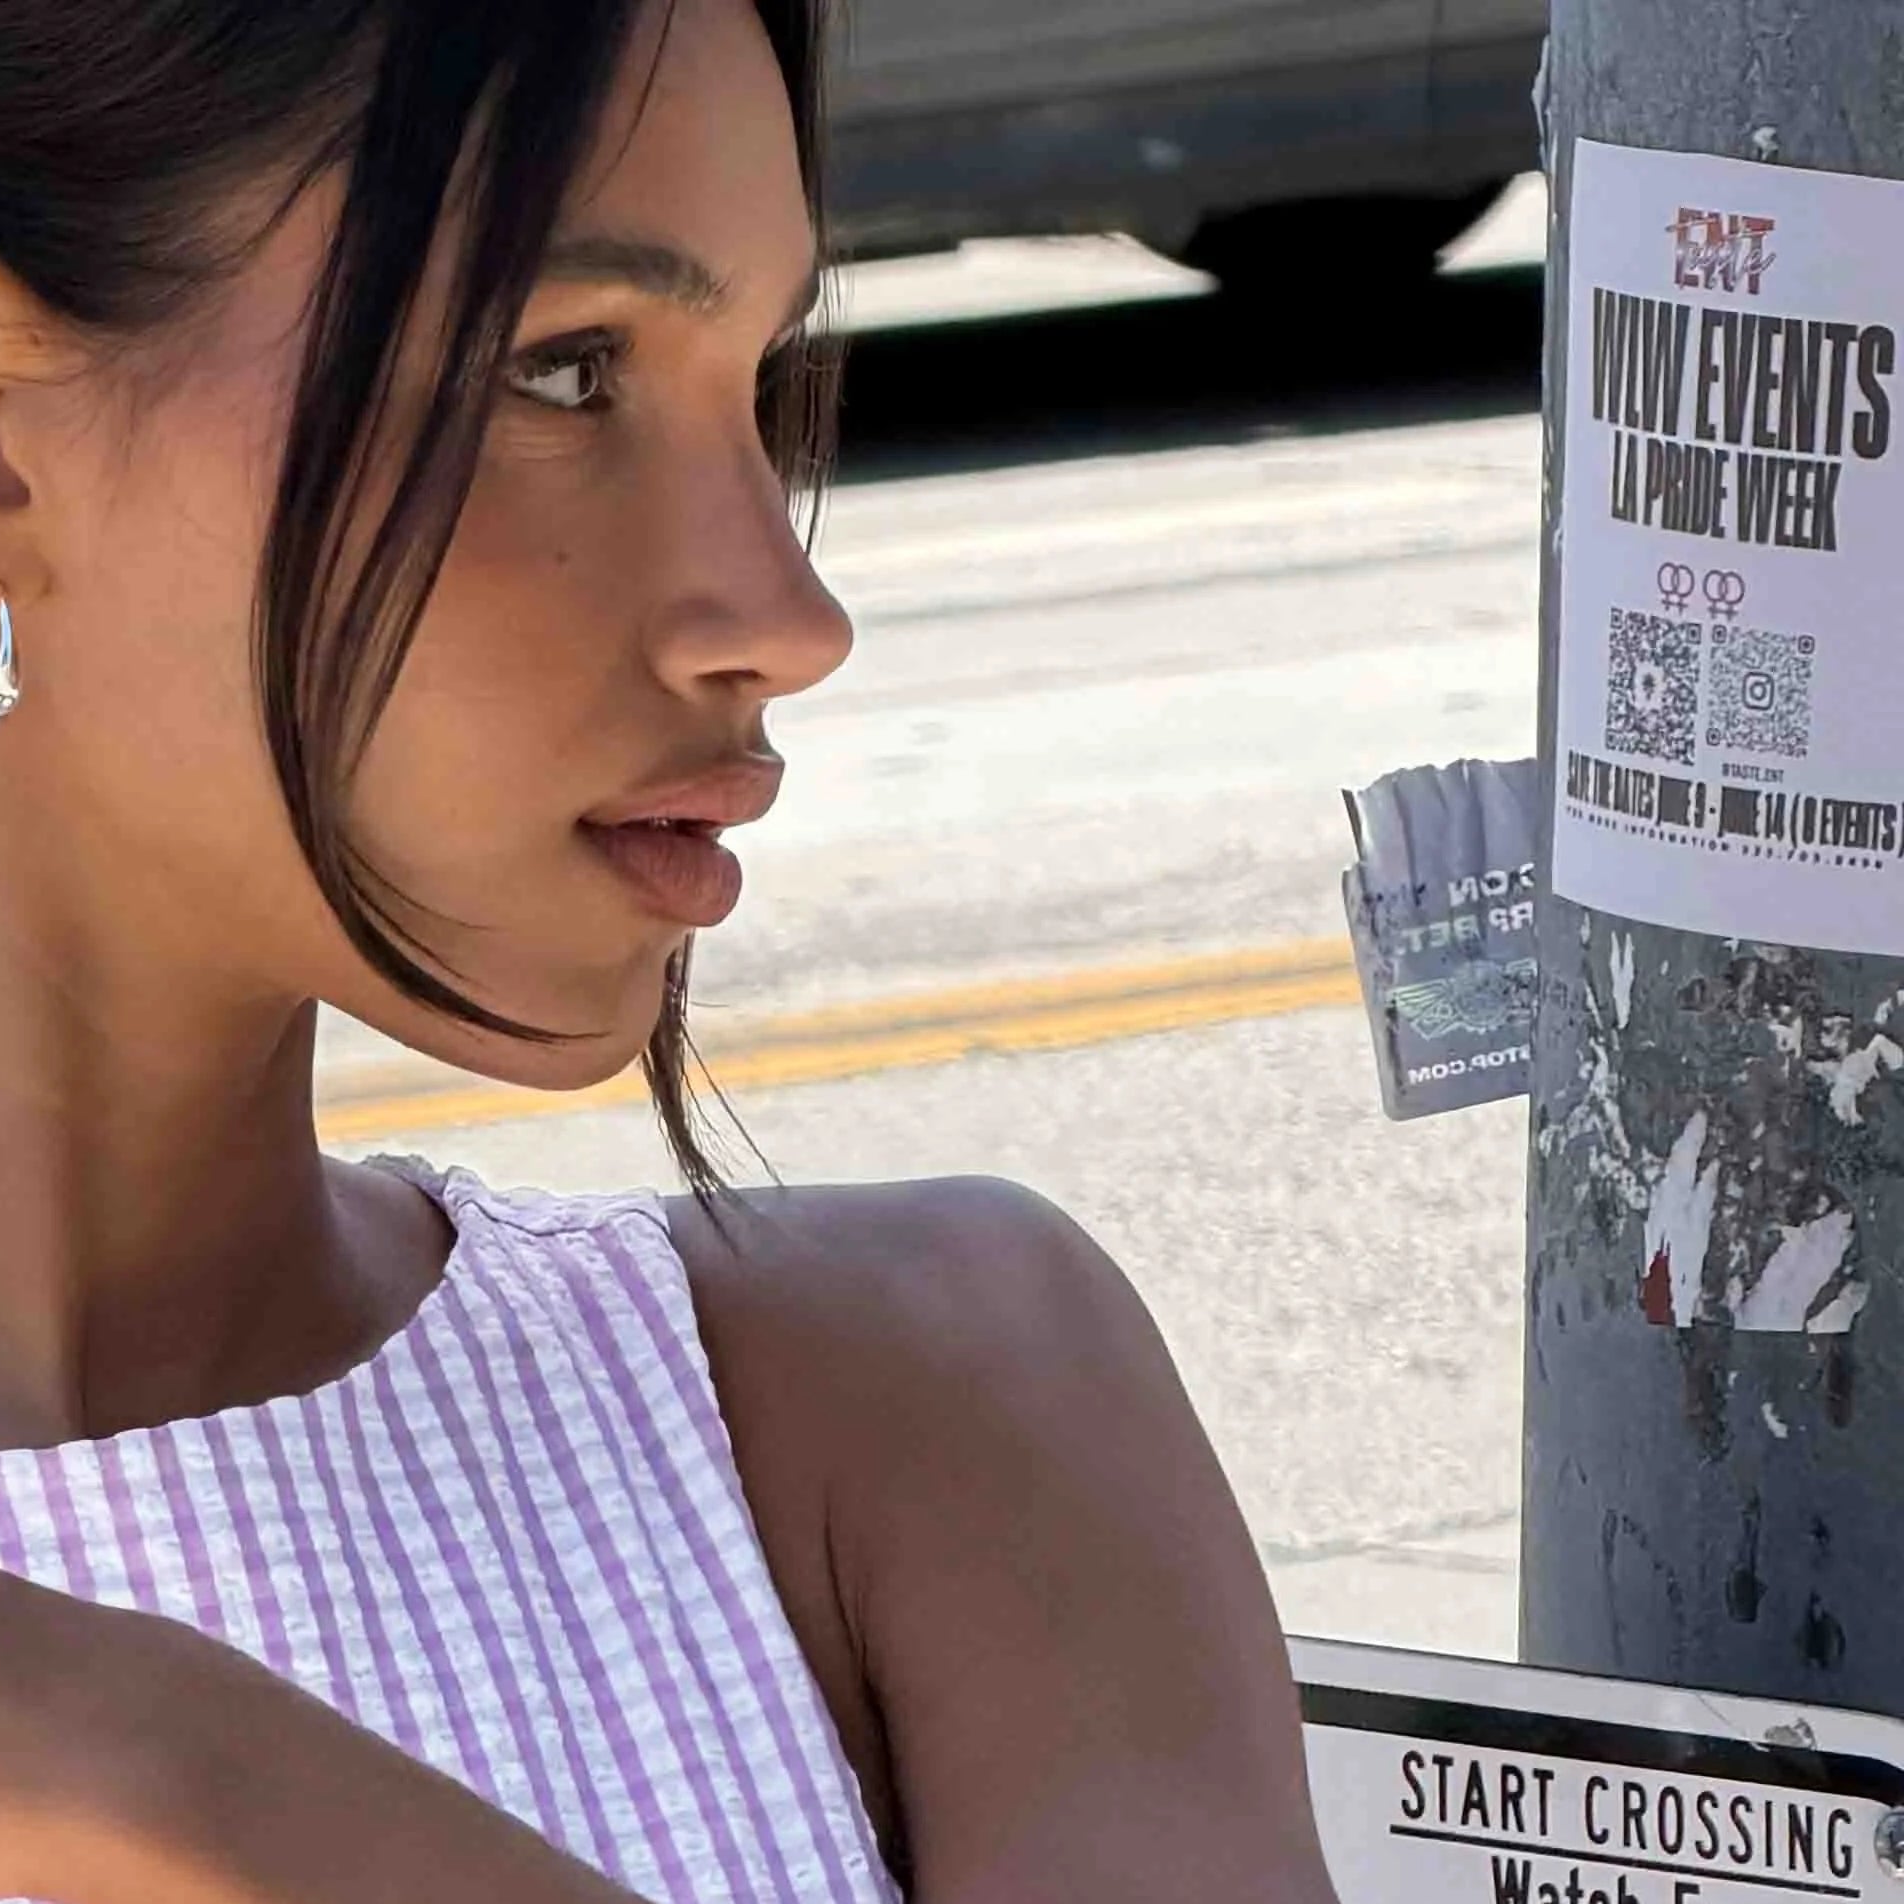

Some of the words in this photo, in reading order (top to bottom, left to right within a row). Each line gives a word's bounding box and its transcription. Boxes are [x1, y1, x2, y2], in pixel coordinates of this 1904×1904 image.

[1695, 308, 1894, 459] EVENTS
[1612, 430, 1637, 523] LA
[1643, 437, 1730, 539] PRIDE
[1737, 452, 1842, 552] WEEK
[1593, 758, 1612, 810] THE
[1614, 765, 1654, 819] DATES
[1820, 799, 1897, 851] EVENTS
[1625, 824, 1729, 851] INFORMATION
[1401, 1750, 1554, 1836] START
[1585, 1776, 1853, 1879] CROSSING
